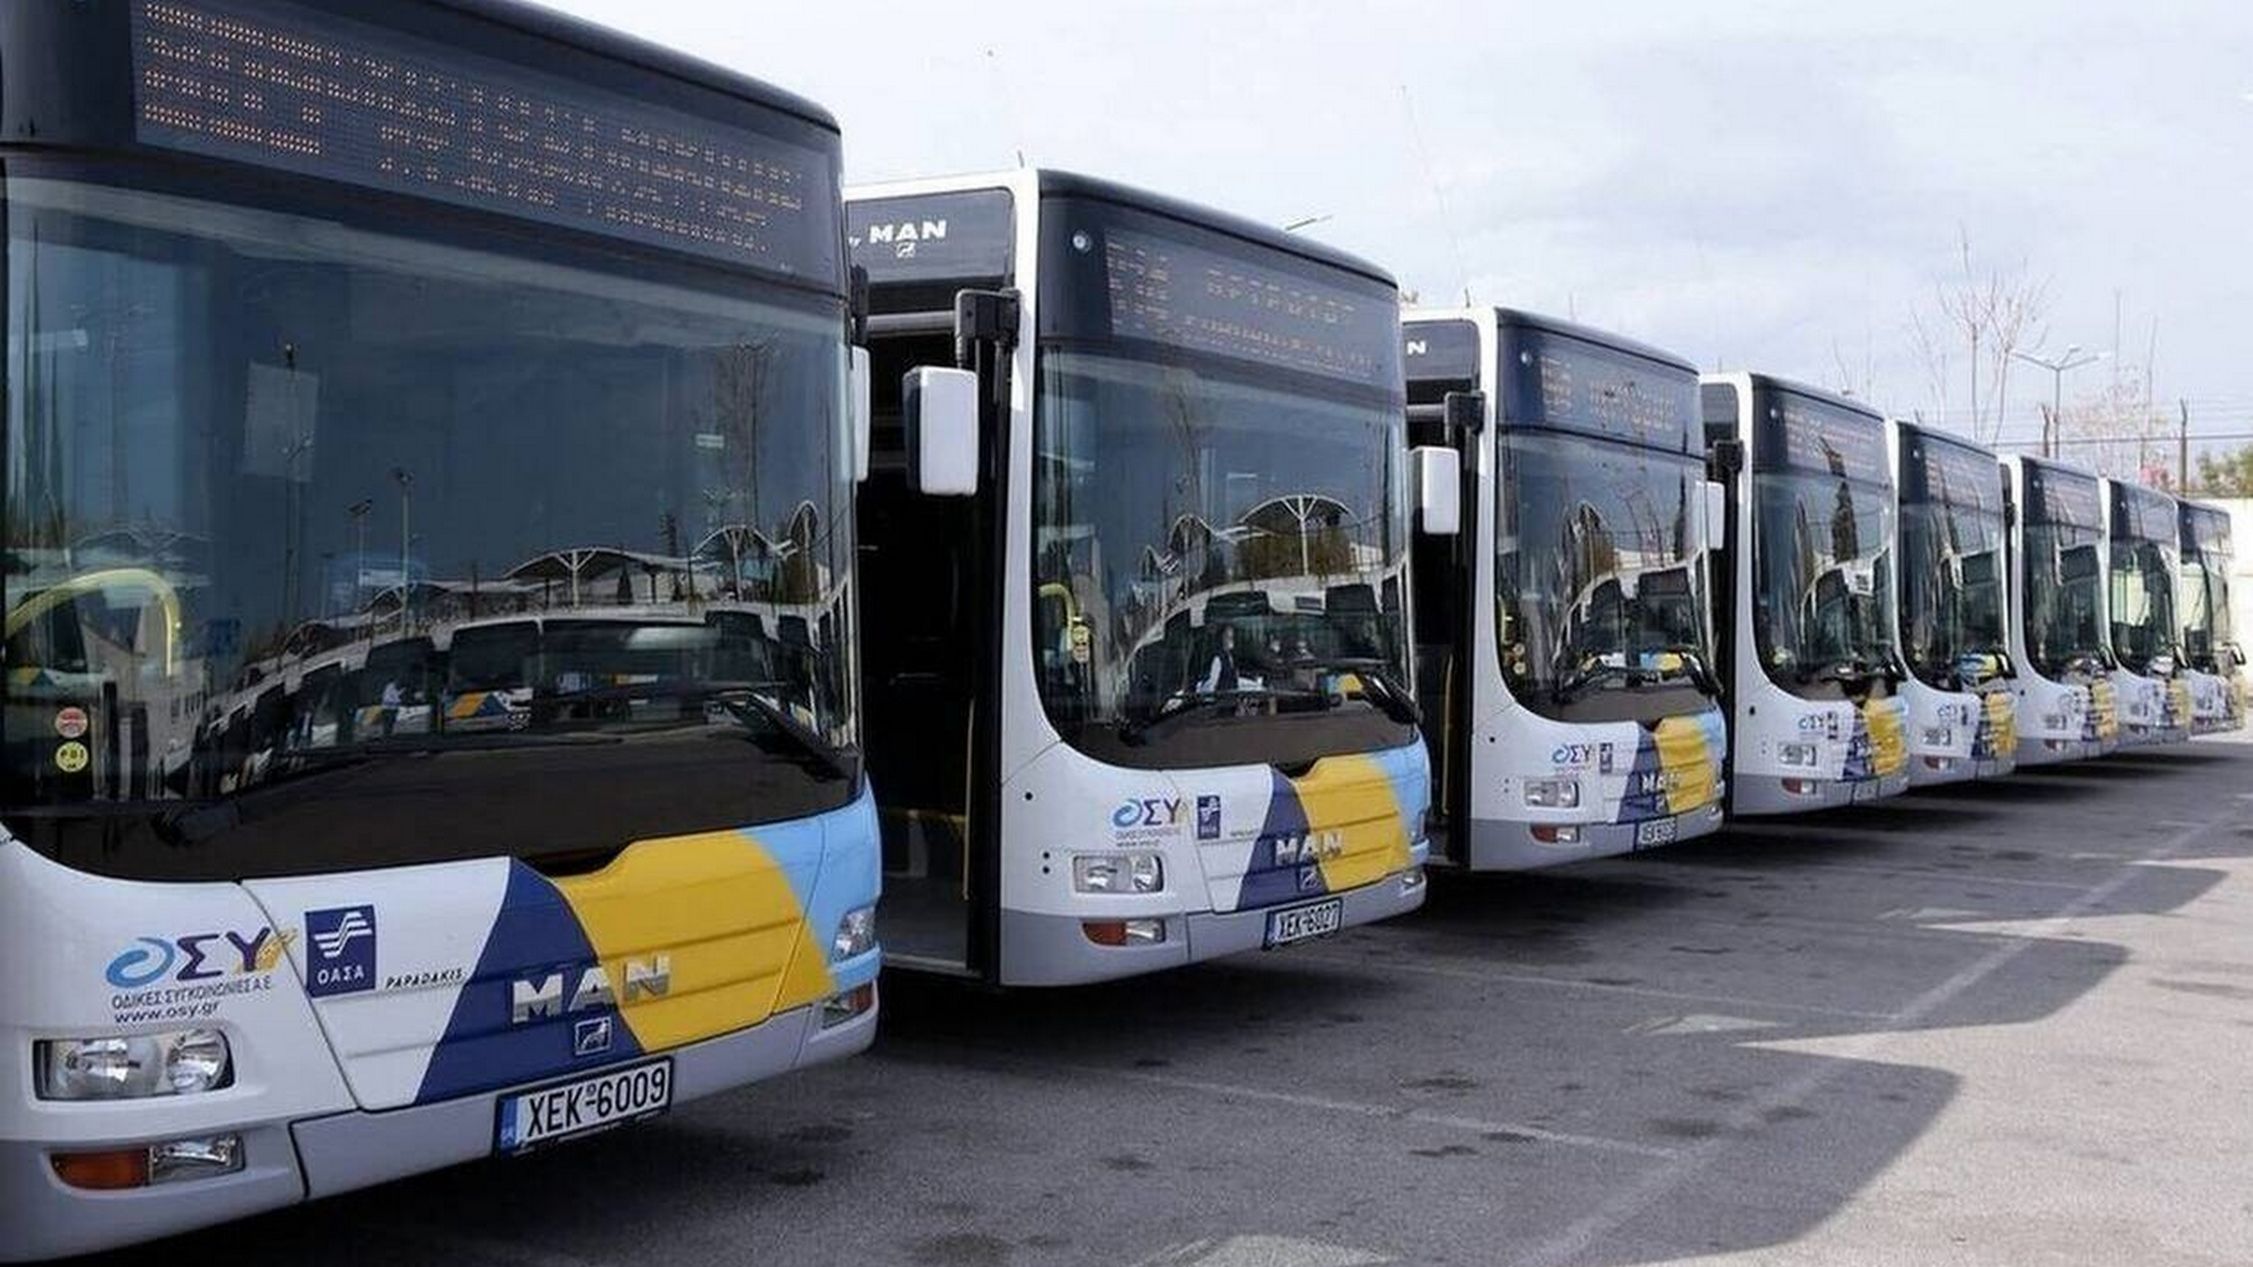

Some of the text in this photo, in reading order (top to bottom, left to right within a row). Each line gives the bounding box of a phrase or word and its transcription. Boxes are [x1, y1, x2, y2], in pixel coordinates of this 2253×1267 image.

[869, 219, 947, 244] MAN
[1275, 830, 1344, 867] MAN
[317, 964, 365, 985] ΟΑΣΑ
[385, 966, 464, 990] PAPADAKIS
[512, 954, 671, 1025] MAN
[114, 1000, 220, 1024] www.osy.gr
